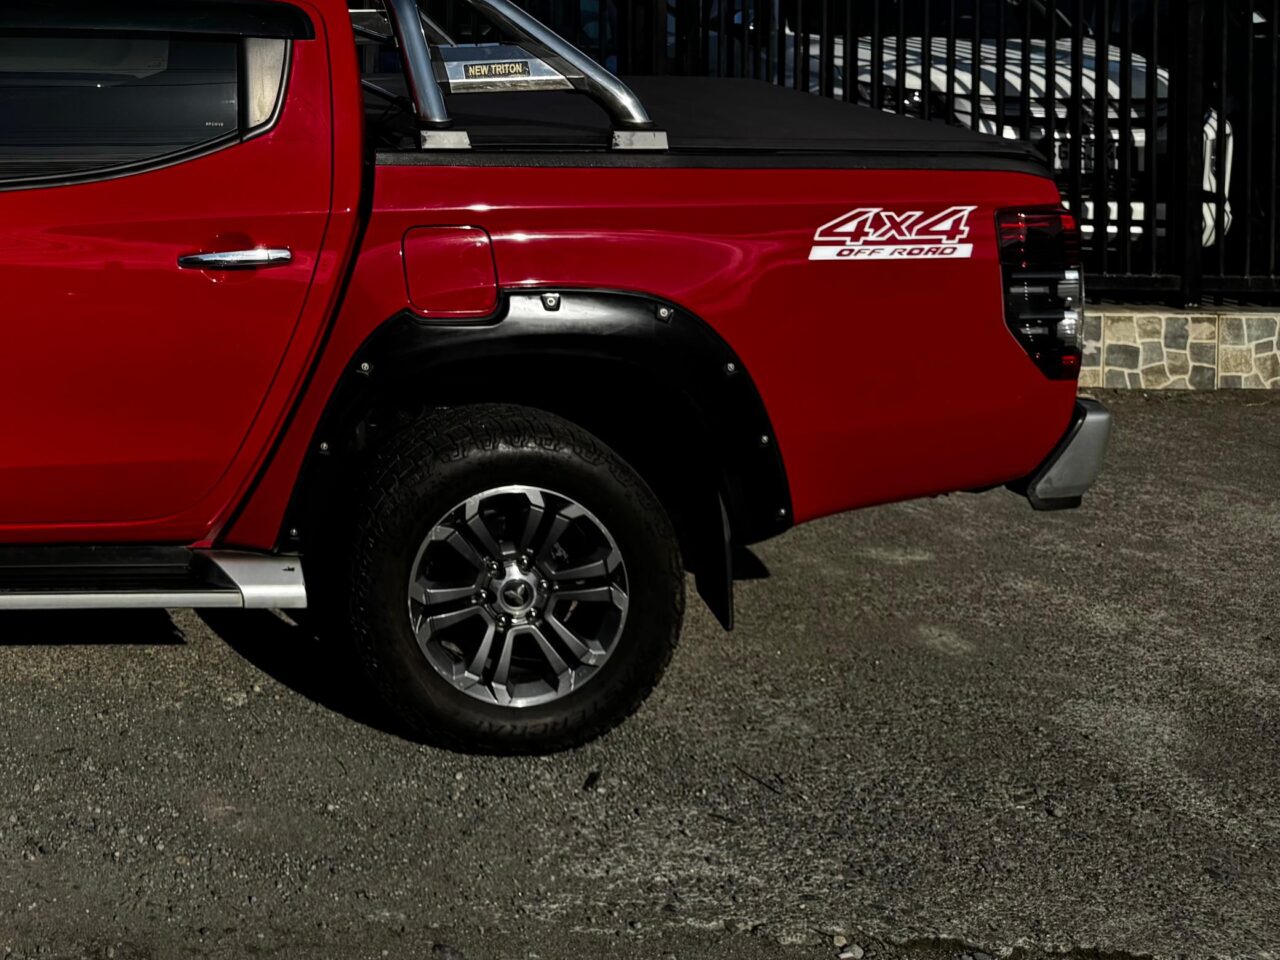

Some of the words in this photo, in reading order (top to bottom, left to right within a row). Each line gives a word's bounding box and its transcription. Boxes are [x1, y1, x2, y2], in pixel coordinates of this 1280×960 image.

[468, 65, 489, 76] NEW
[490, 63, 523, 75] TRITON
[836, 248, 885, 257] OFF
[888, 247, 958, 257] ROAD
